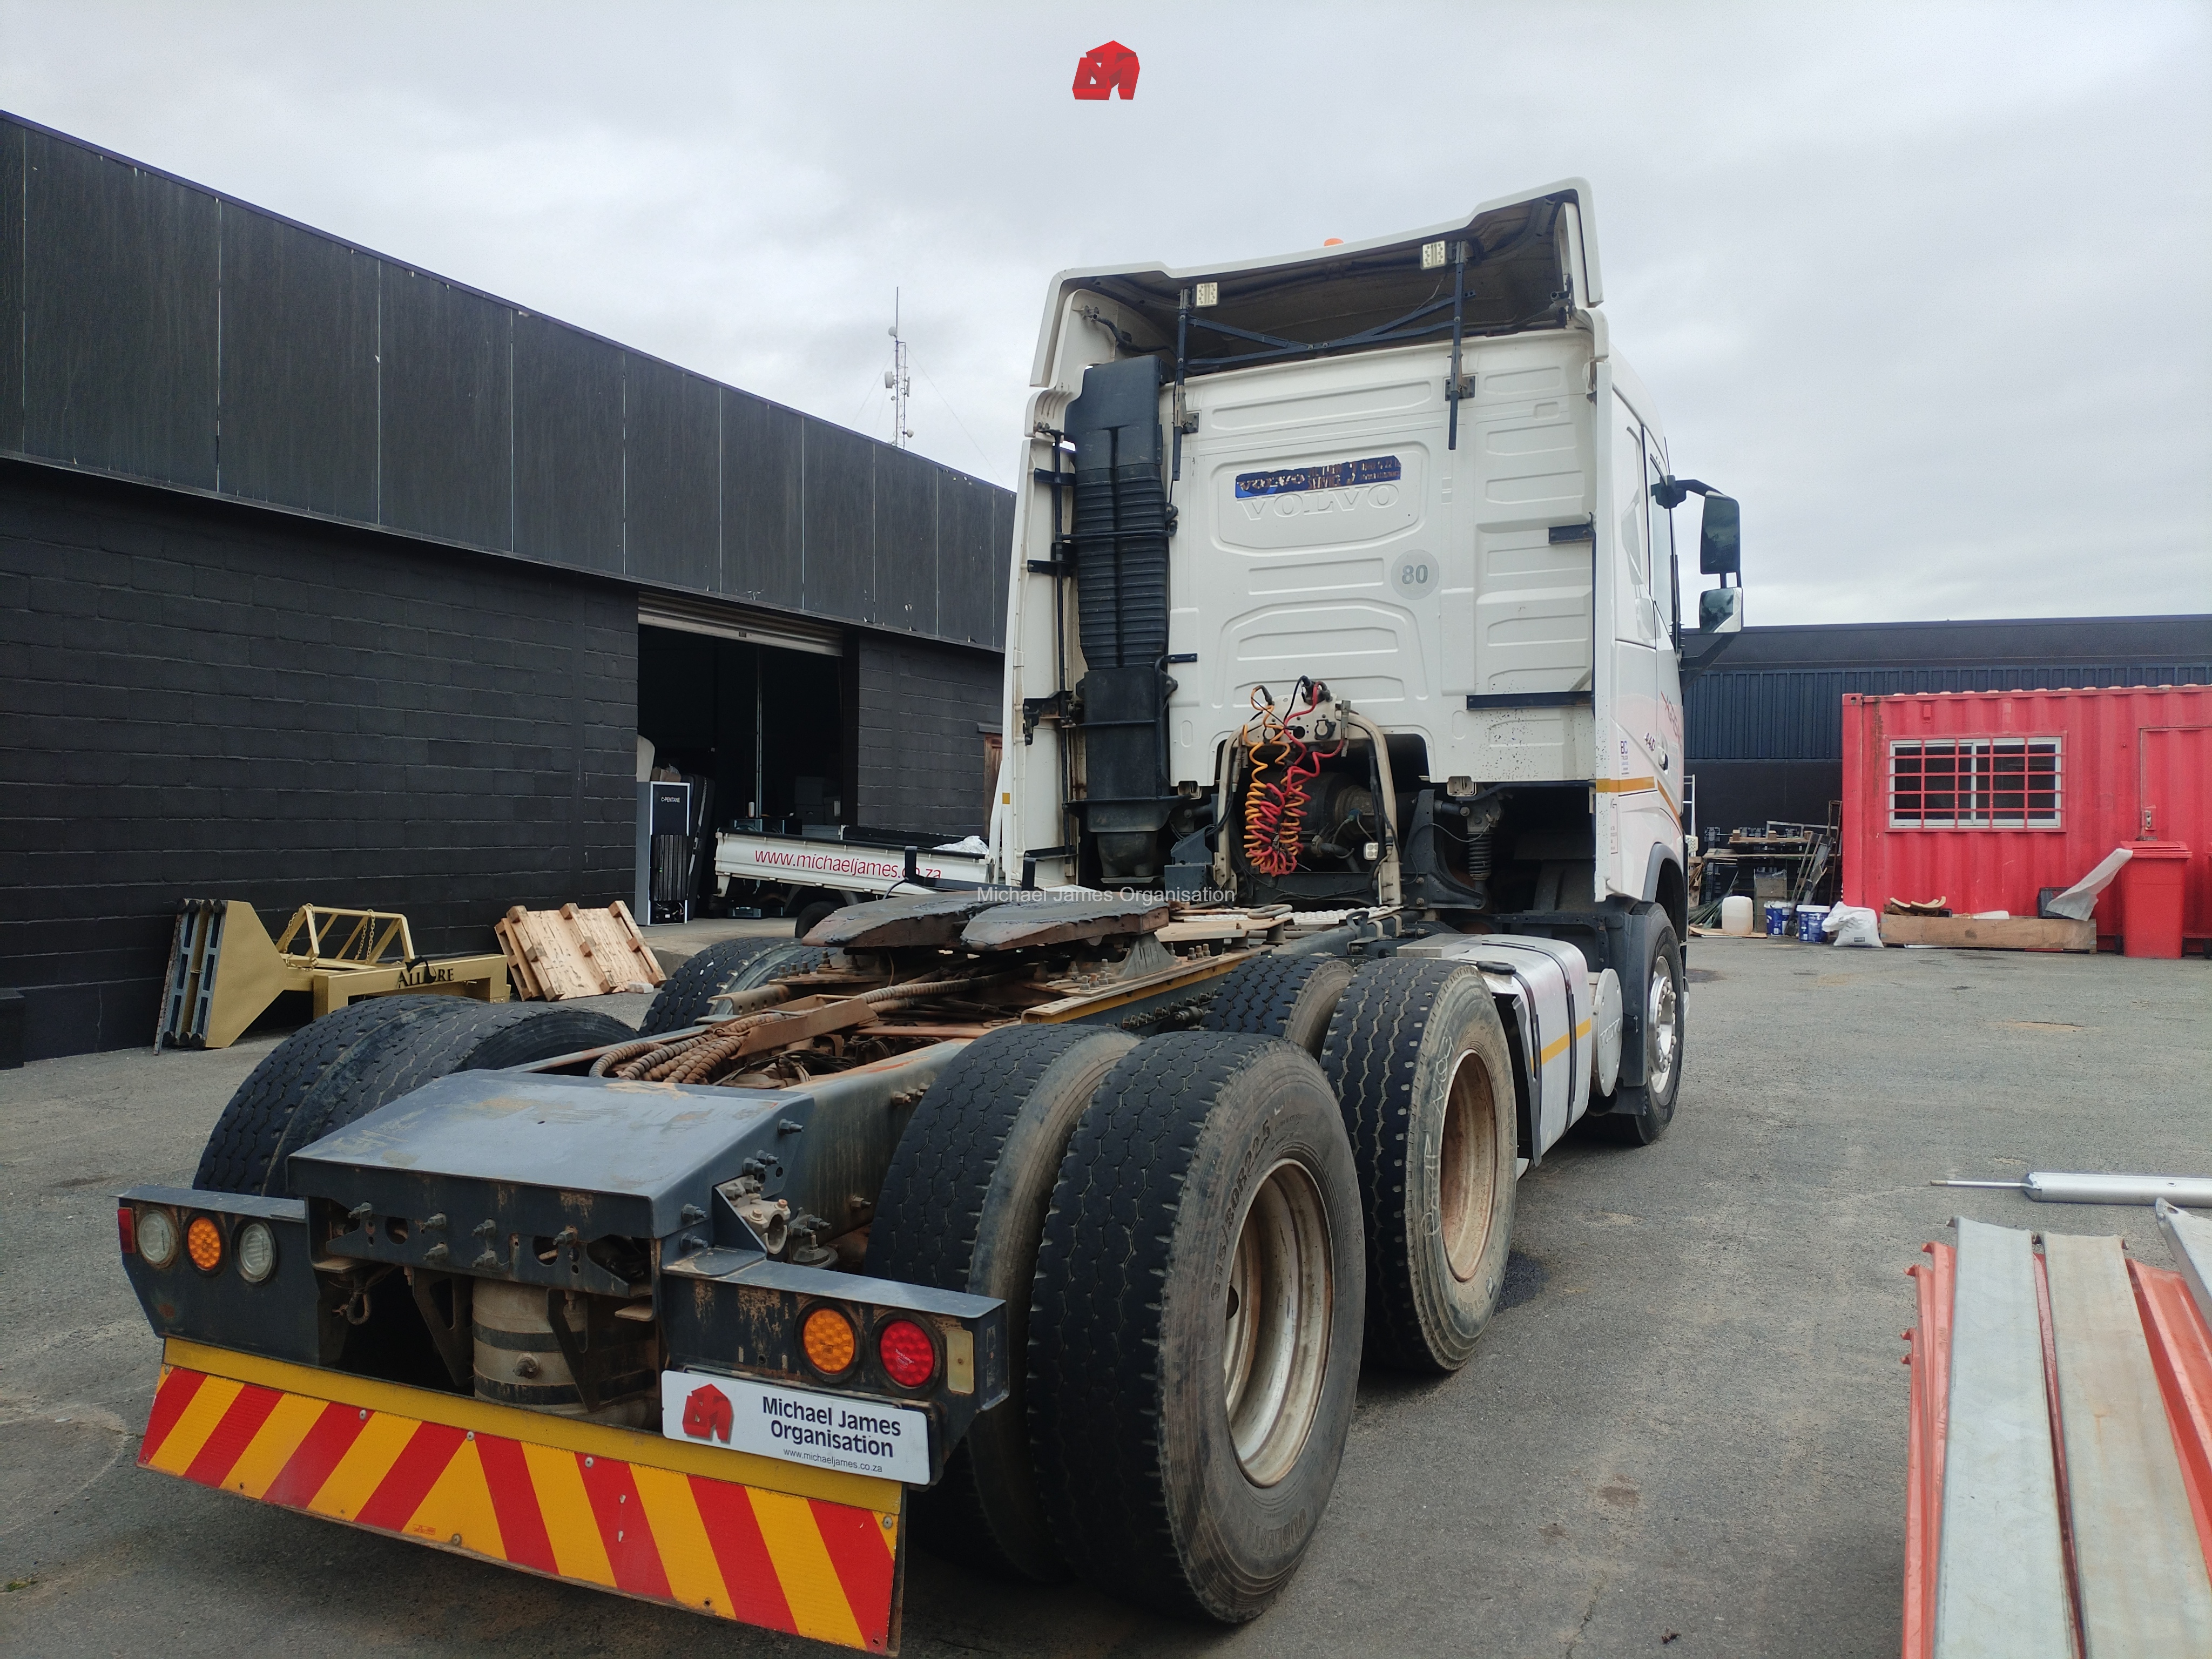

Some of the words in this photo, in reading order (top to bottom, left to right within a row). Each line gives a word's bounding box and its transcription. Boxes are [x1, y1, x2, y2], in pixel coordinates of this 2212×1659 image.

[1236, 484, 1400, 521] VOLVO
[1401, 564, 1428, 585] 80
[763, 1396, 833, 1426] Michael
[838, 1410, 901, 1437] James
[771, 1420, 894, 1458] Organisation
[783, 1448, 883, 1473] www.michaeljames.co.za
